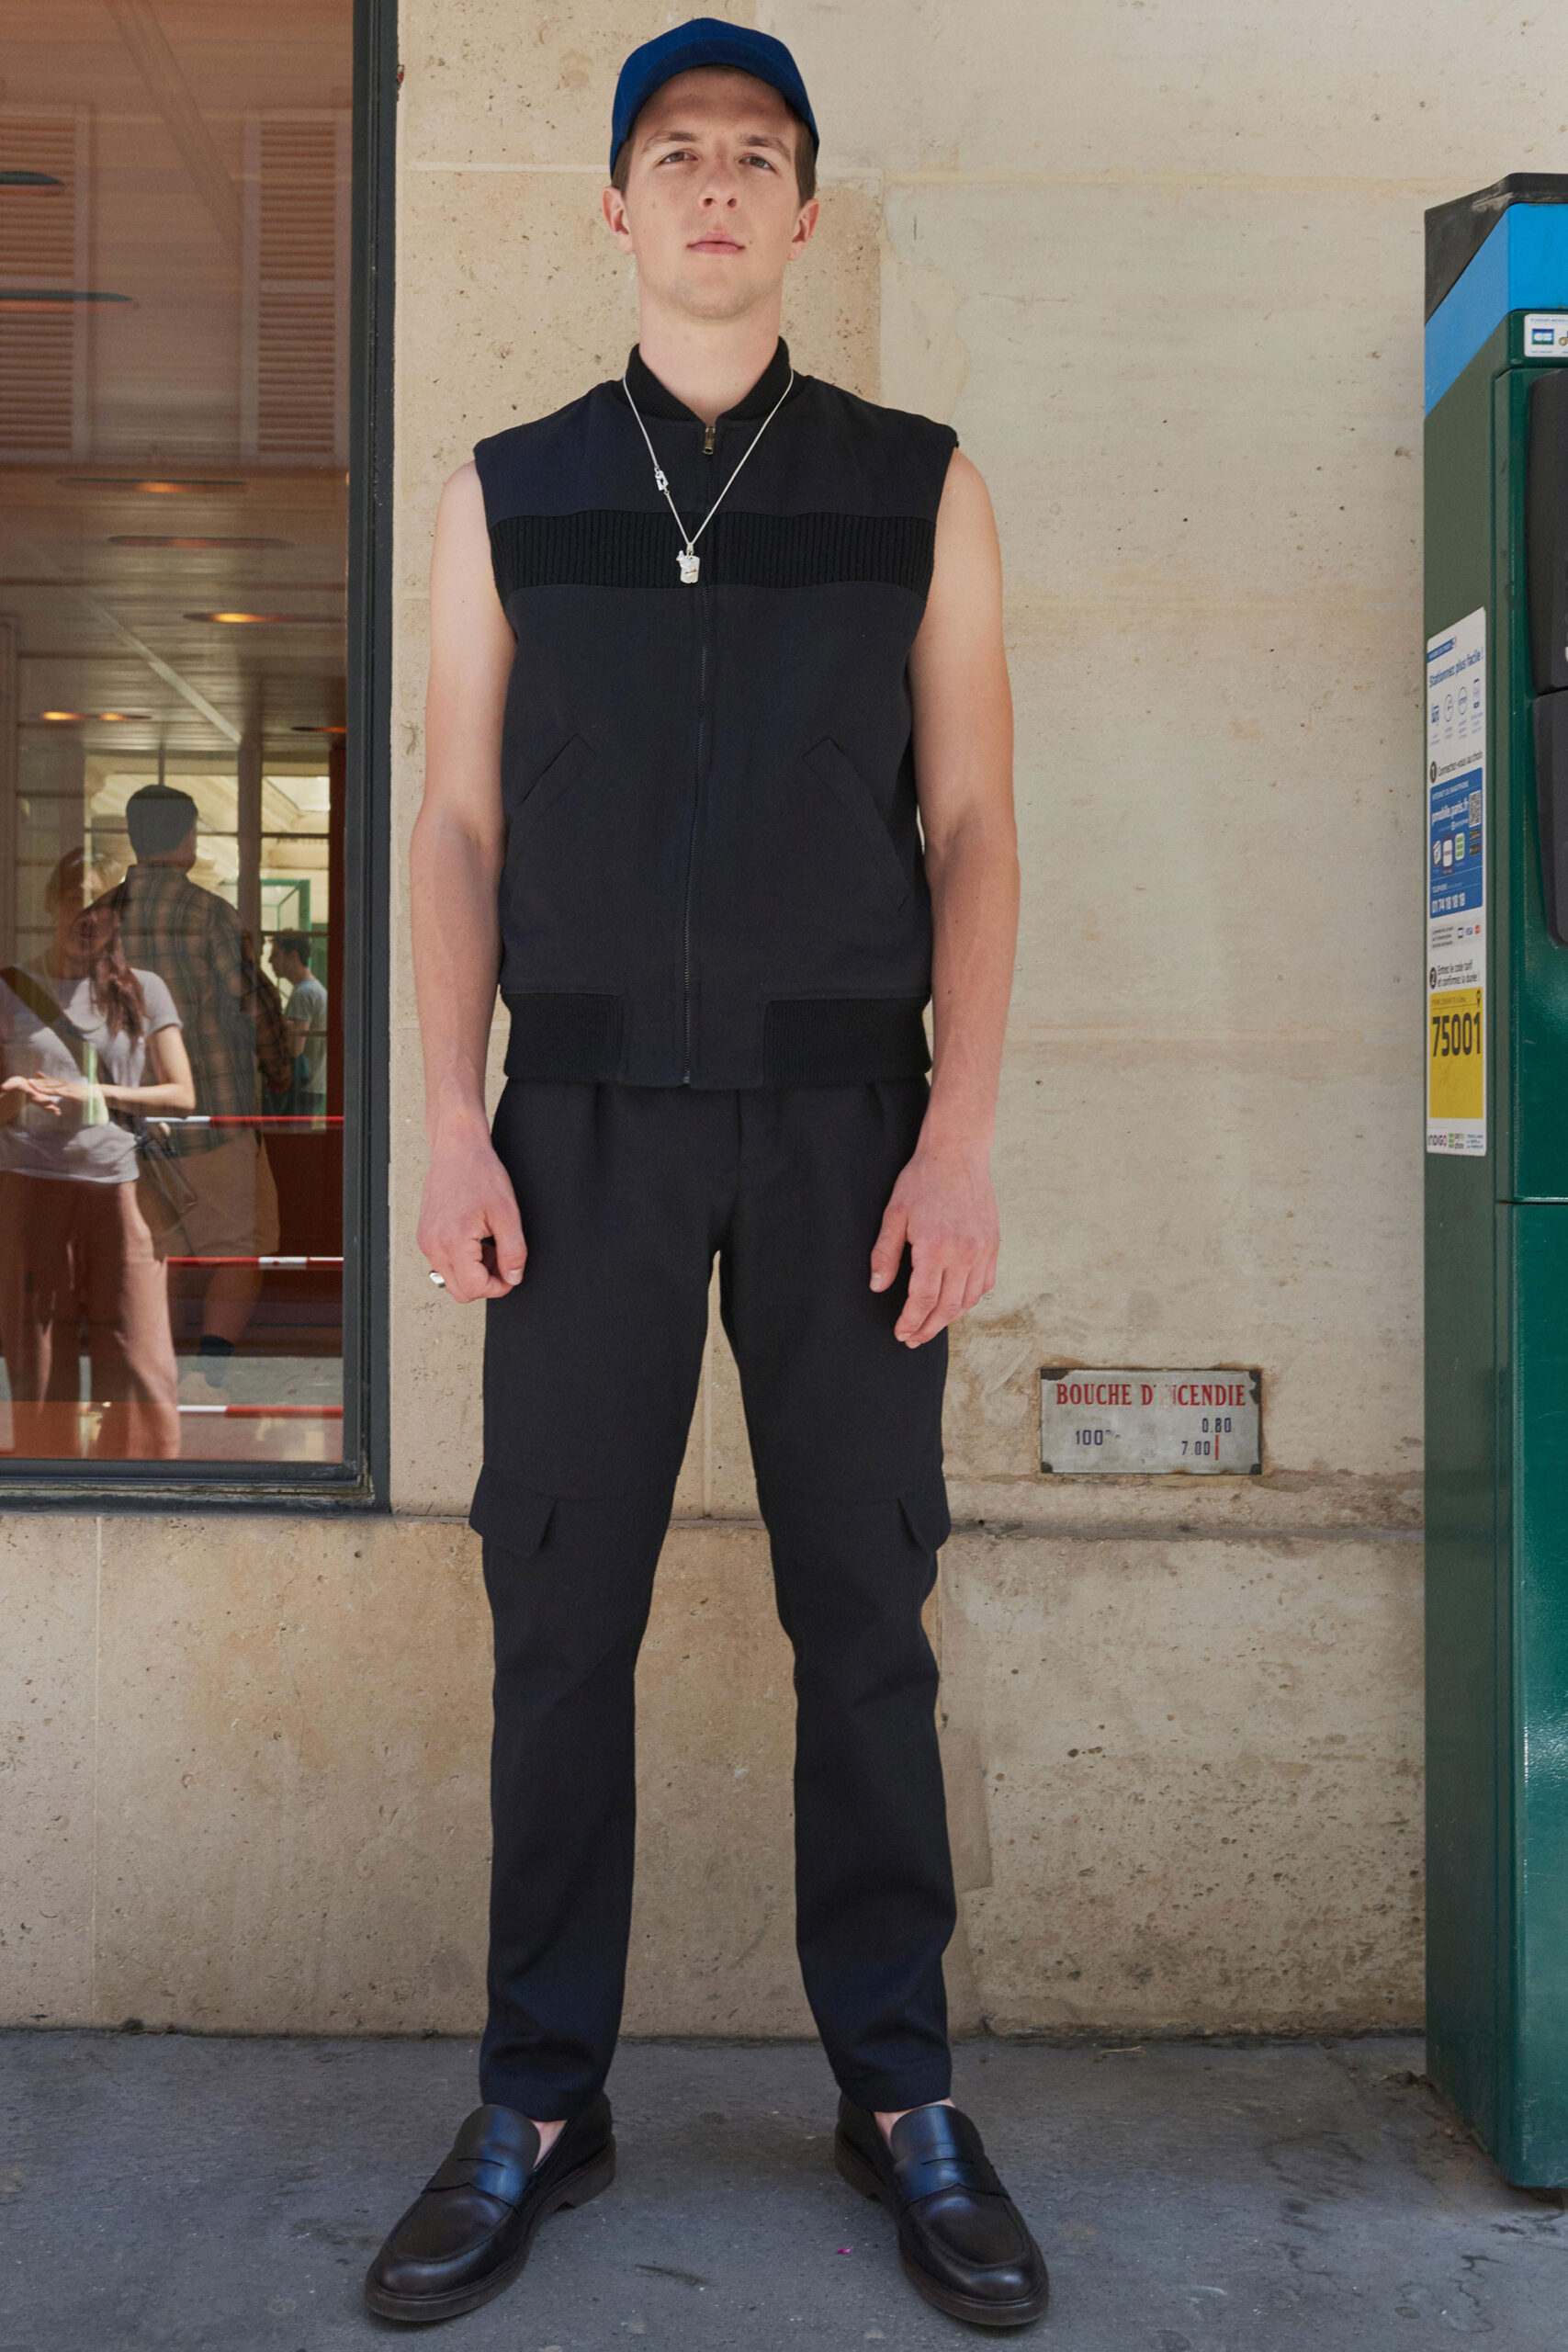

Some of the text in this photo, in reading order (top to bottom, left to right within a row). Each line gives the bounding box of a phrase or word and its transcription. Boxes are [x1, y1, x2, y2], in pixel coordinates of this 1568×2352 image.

[1432, 1012, 1481, 1057] 75001
[1056, 1384, 1246, 1407] BOUCHE D'CENDIE
